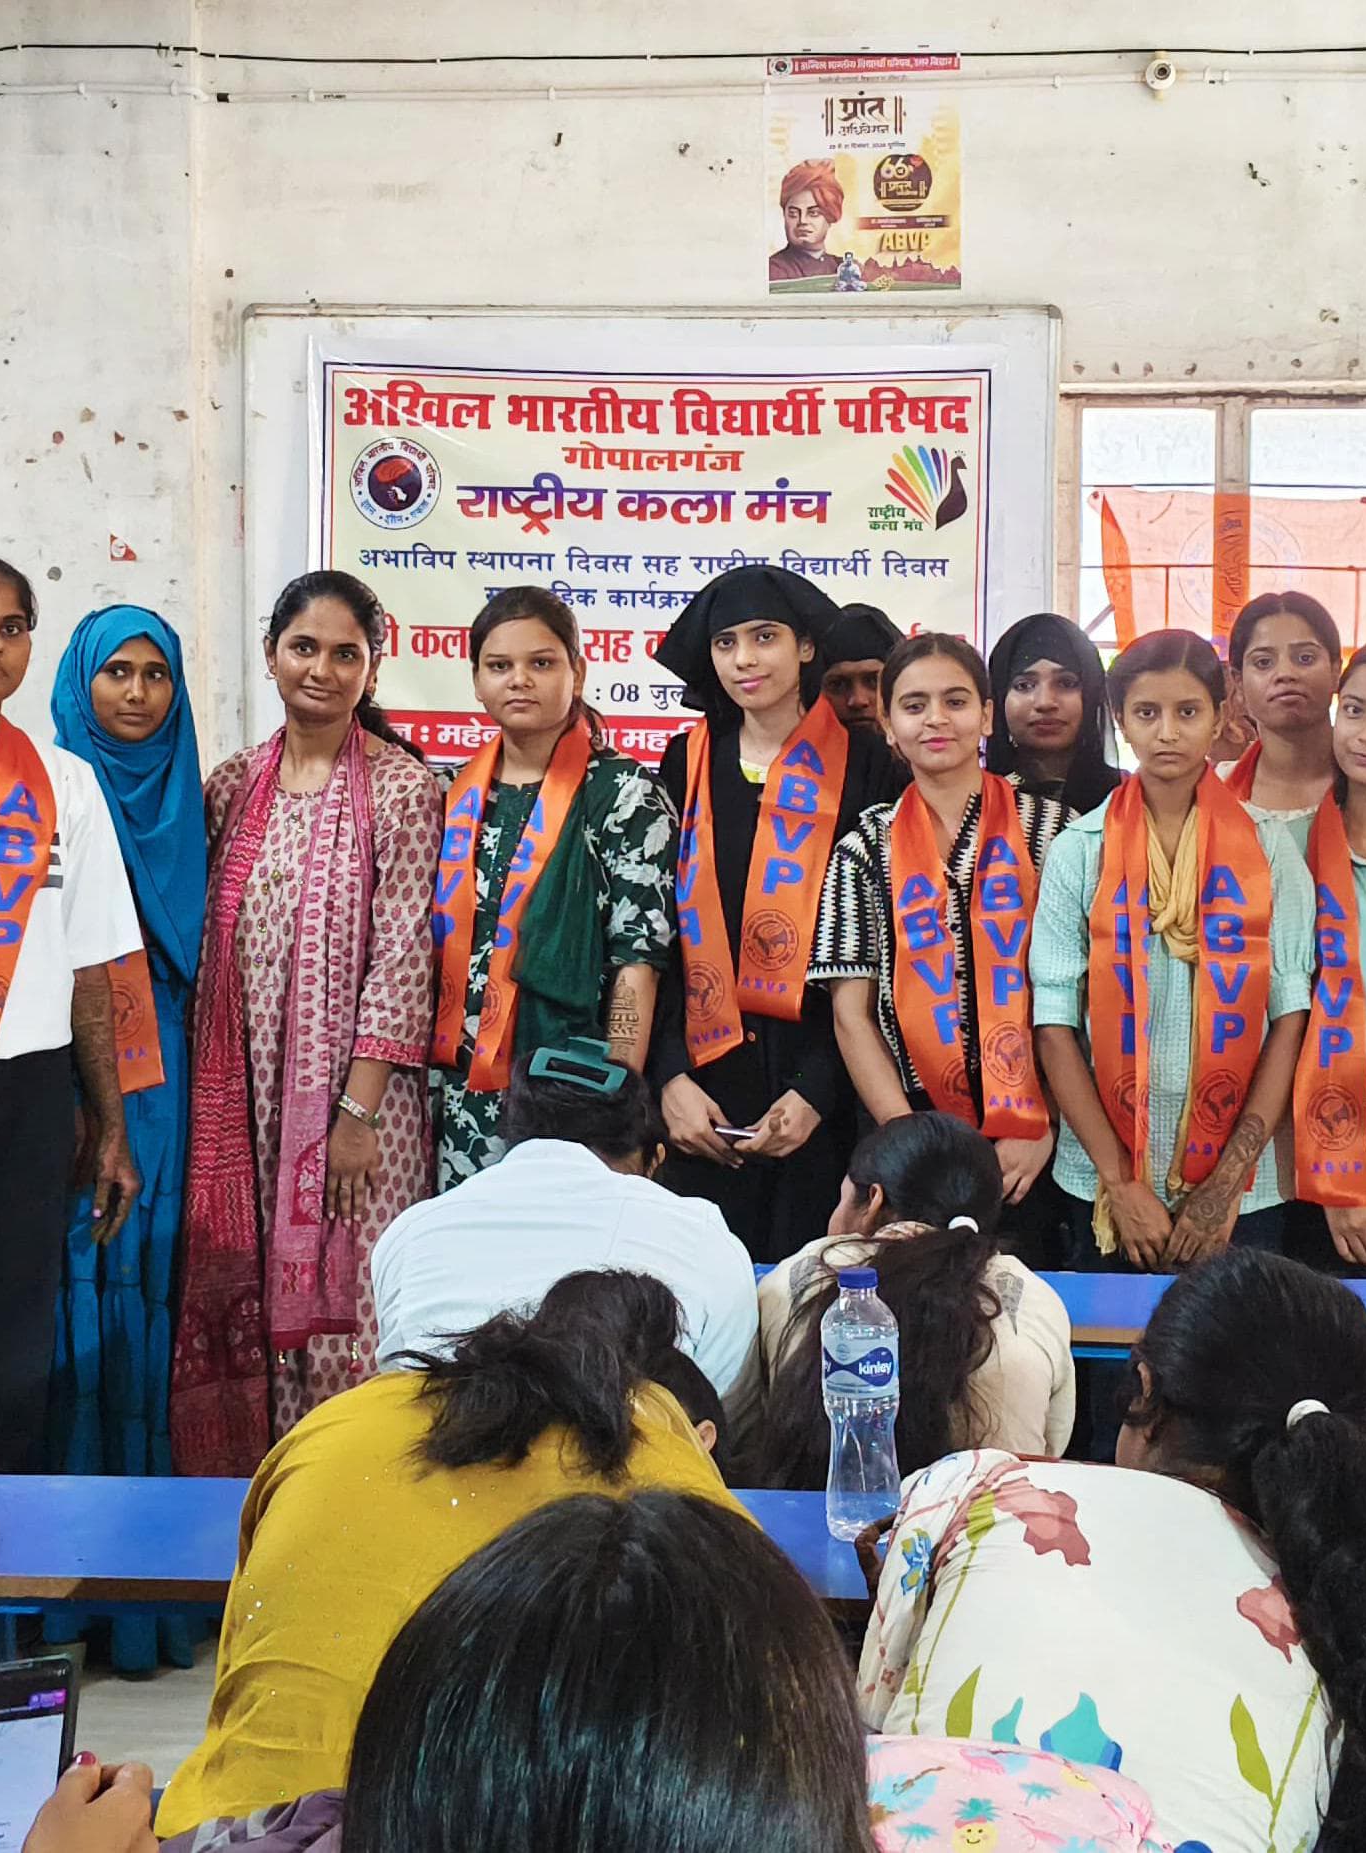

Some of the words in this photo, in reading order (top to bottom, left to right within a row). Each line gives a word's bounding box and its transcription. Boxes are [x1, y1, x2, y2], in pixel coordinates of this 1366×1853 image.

[344, 380, 495, 430] अखिल
[508, 387, 663, 434] भारतीय
[670, 388, 826, 436] विद्यार्थी
[834, 386, 972, 434] परिषद
[562, 441, 745, 472] गोपालगंज
[456, 472, 608, 535] राष्ट्रीय
[616, 489, 737, 524] कला
[745, 477, 832, 524] मंच
[359, 542, 456, 570] अभाविप
[467, 549, 555, 571] स्थापना
[566, 546, 632, 574] दिवस
[643, 555, 681, 577] सह
[881, 550, 949, 577] दिवस
[583, 629, 633, 664] सह
[611, 683, 640, 702] 08
[762, 739, 825, 895] ABVP
[431, 784, 483, 948] ABVP
[977, 835, 1028, 1006] ABVP
[897, 872, 963, 1046] ABVP
[1201, 865, 1250, 1055] ABVP
[1315, 883, 1354, 1069] ABVP
[858, 1360, 892, 1376] kinley
